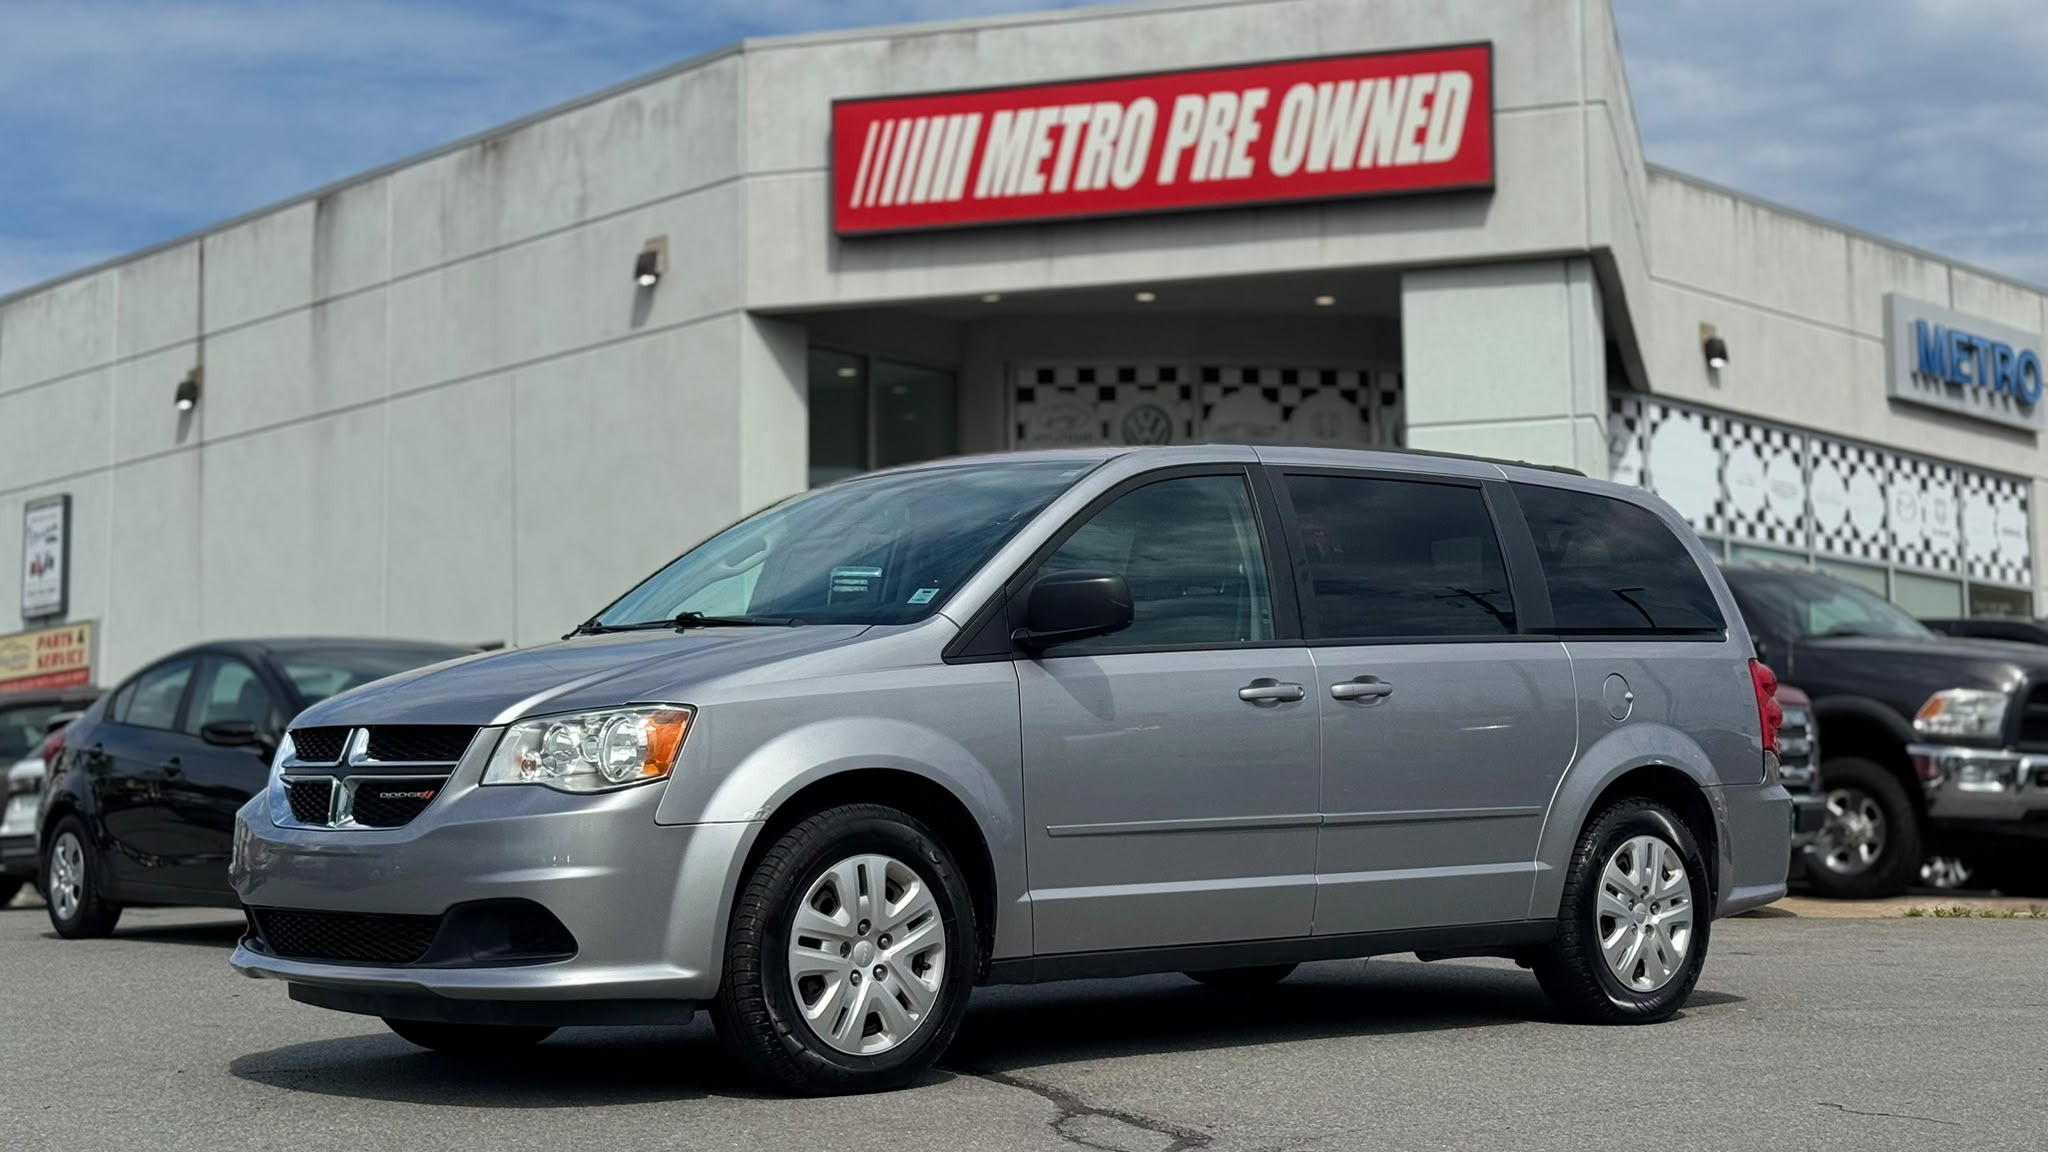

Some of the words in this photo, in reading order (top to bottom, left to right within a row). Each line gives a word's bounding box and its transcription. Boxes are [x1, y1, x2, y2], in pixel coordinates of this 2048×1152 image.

[973, 97, 1159, 200] METRO
[1157, 89, 1269, 185] PRE
[1268, 70, 1474, 177] OWNED
[1915, 318, 2043, 405] METRO
[37, 631, 73, 649] PARTS
[37, 649, 84, 669] SERVICE
[380, 791, 425, 799] DODGE
